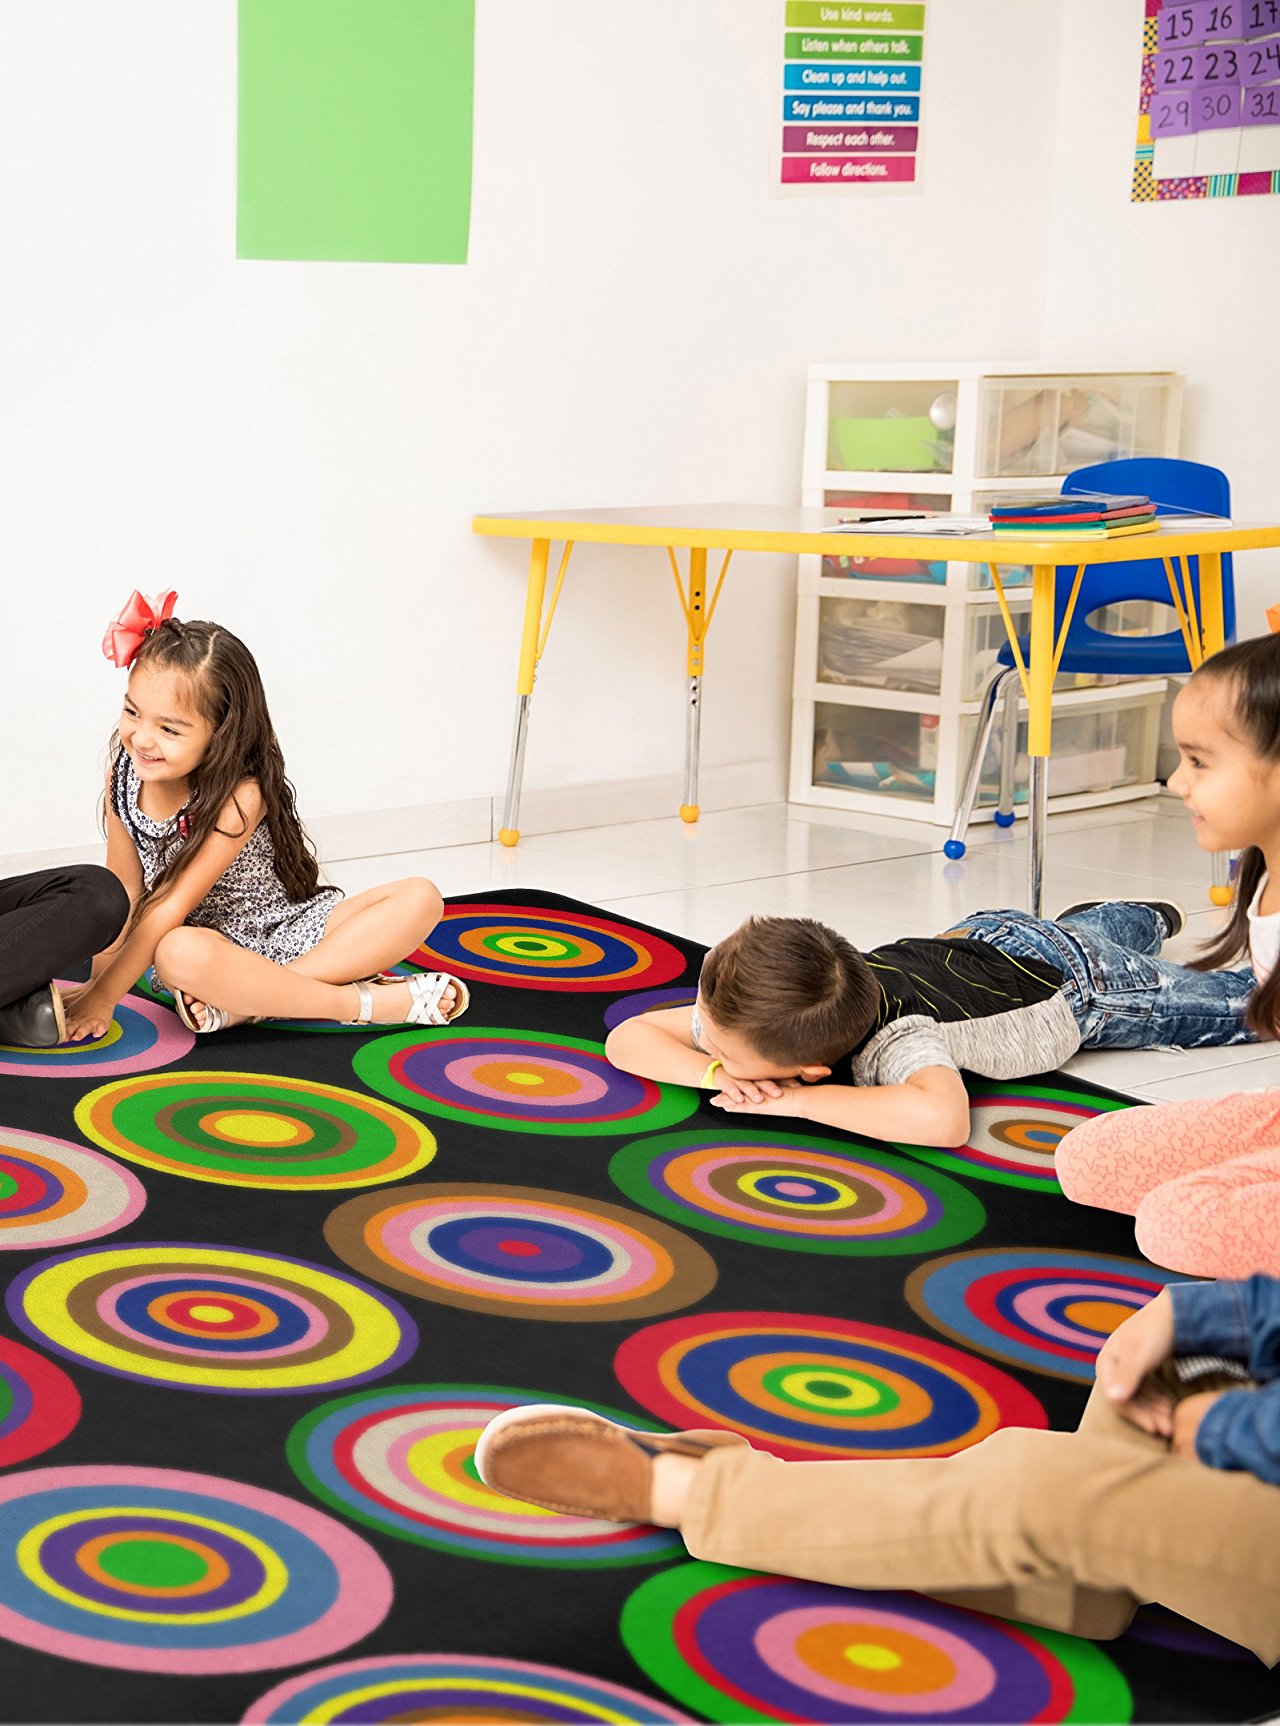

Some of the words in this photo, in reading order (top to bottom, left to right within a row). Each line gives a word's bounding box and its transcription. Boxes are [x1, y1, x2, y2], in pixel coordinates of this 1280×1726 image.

[820, 8, 838, 21] Use
[841, 8, 861, 22] kind
[864, 9, 894, 22] words.
[1164, 9, 1194, 41] 15
[1205, 5, 1233, 32] 16
[1249, 1, 1279, 29] 17
[801, 39, 829, 52] Listen
[831, 40, 857, 53] when
[859, 40, 889, 53] others
[891, 40, 910, 54] talk.
[1164, 56, 1194, 84] 22
[1204, 50, 1238, 80] 23
[1248, 44, 1280, 76] 24
[802, 70, 830, 84] Clean
[831, 72, 845, 86] up
[847, 71, 865, 84] and
[867, 71, 887, 86] help
[890, 72, 907, 84] out.
[792, 101, 810, 117] Say
[812, 101, 843, 117] please
[845, 101, 864, 115] and
[866, 101, 892, 115] thank
[894, 103, 912, 117] you.
[1157, 101, 1189, 129] 29
[1201, 94, 1232, 121] 30
[1251, 91, 1279, 118] 31
[806, 132, 843, 148] Respect
[844, 132, 868, 146] each
[870, 132, 895, 146] other.
[810, 163, 840, 177] Follow
[842, 162, 888, 176] directions.
